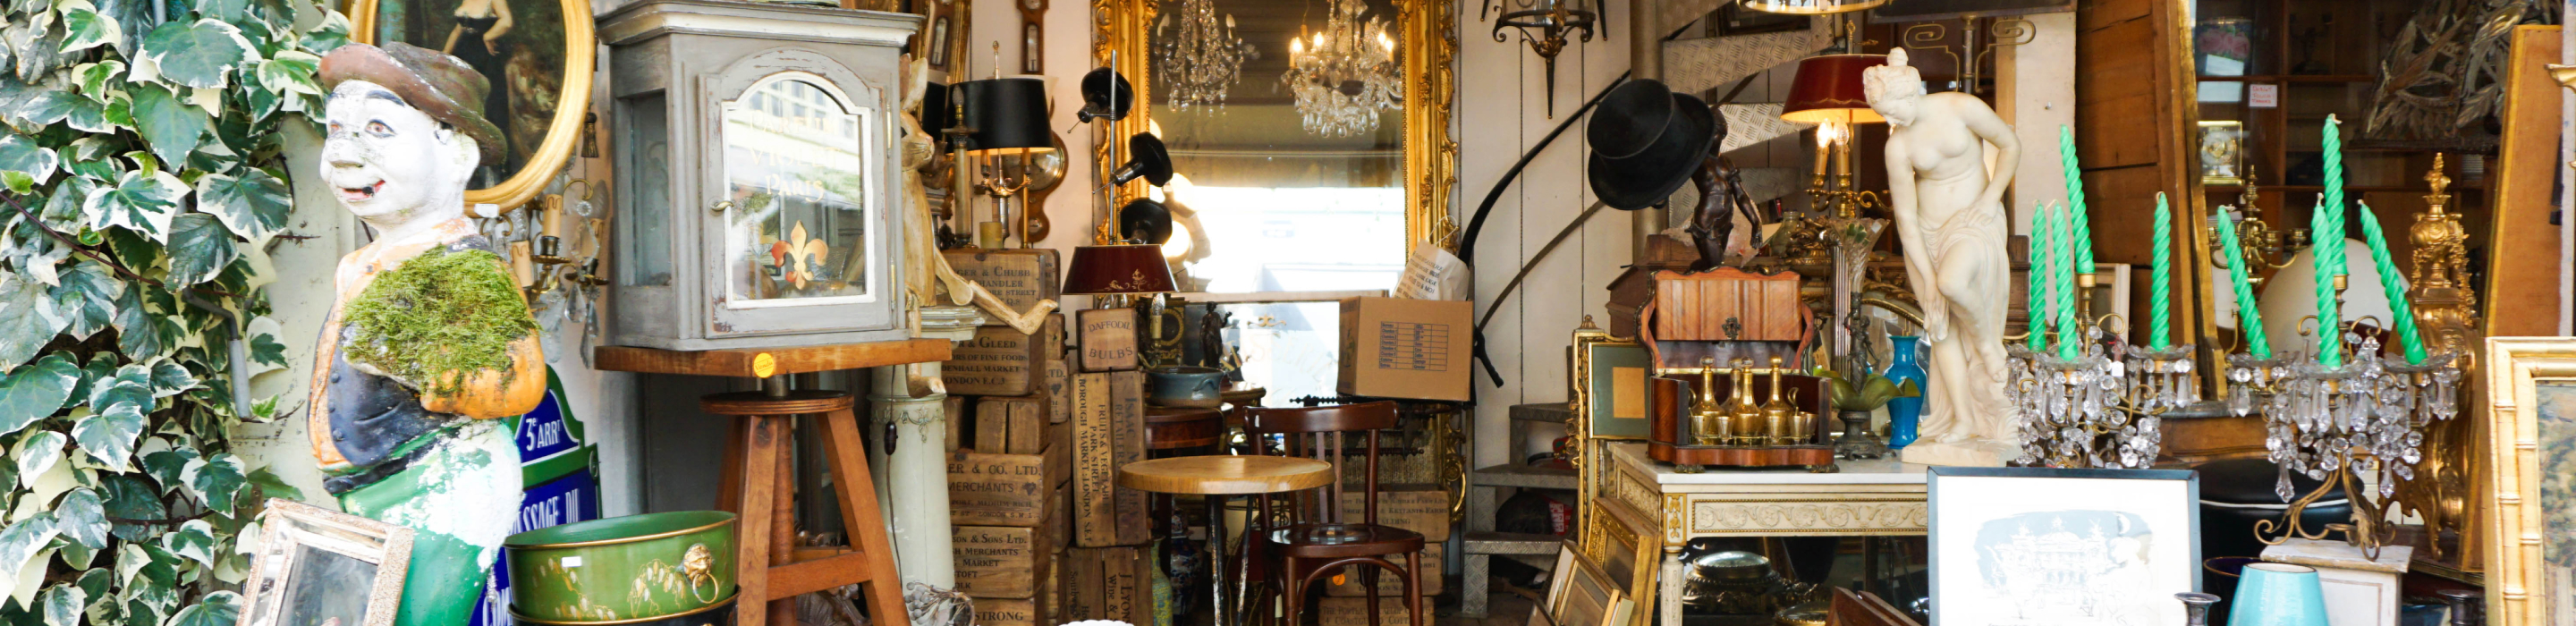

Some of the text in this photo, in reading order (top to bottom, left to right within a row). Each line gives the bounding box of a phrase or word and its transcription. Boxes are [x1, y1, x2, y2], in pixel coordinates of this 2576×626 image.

[765, 173, 825, 203] PARIS
[994, 266, 1030, 276] CHUBB
[1089, 320, 1131, 332] DAFFODIL
[979, 335, 1017, 349] GLEED
[1089, 346, 1133, 360] BULBS
[984, 365, 1021, 373] MARKET
[1079, 378, 1088, 427] BOROUGH
[1098, 404, 1106, 439] FRUITS
[1080, 431, 1089, 471] MARKET
[1089, 426, 1099, 492] PARK STREET
[947, 464, 964, 474] ER
[971, 464, 981, 474] &
[988, 464, 1008, 475] CO.
[948, 482, 1014, 493] MERCHANTS
[1082, 478, 1091, 518] LONDON
[970, 535, 979, 543] &
[981, 533, 1003, 544] SONS
[1006, 533, 1028, 544] LTD.
[966, 547, 1019, 555] MERCHANTS
[962, 558, 1000, 567] MARKET
[975, 611, 1024, 621] STRONG
